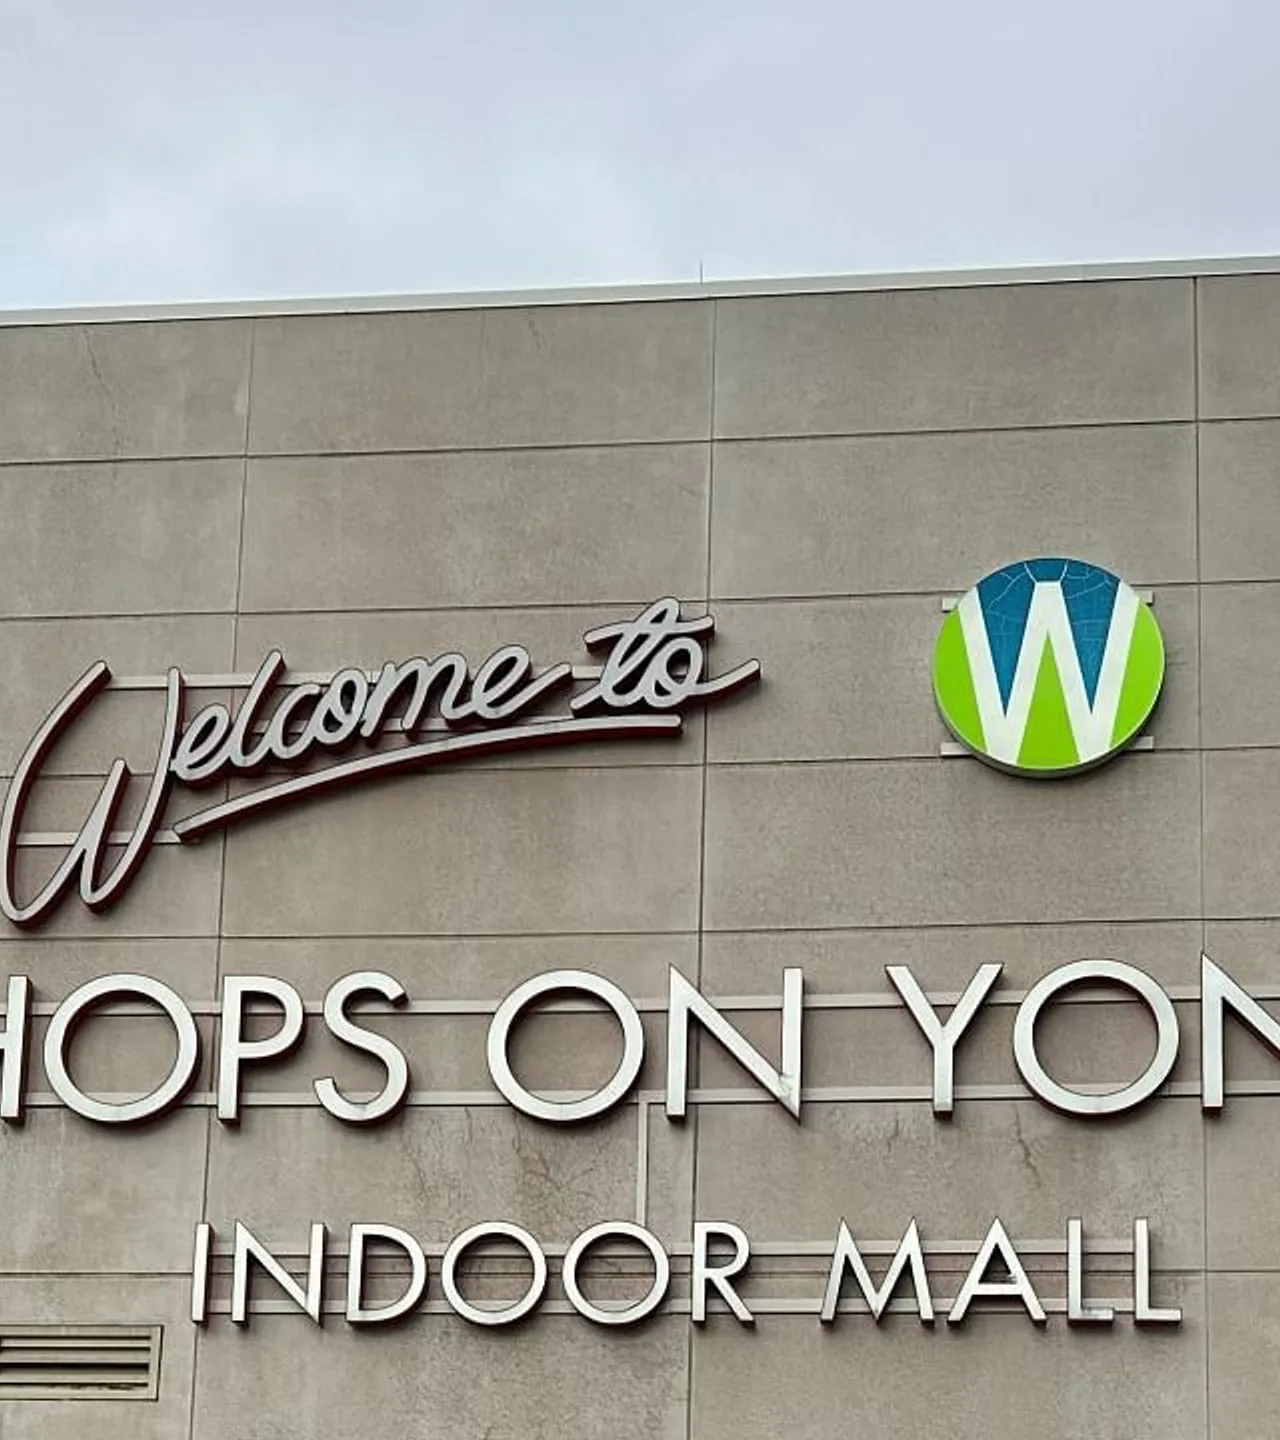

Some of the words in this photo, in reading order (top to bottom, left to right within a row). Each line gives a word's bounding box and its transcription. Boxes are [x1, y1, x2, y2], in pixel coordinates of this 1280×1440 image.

[572, 597, 761, 708] to
[959, 578, 1143, 766] W
[486, 965, 803, 1123] ON
[191, 1220, 756, 1326] INDOOR
[820, 1217, 1183, 1324] MALL
